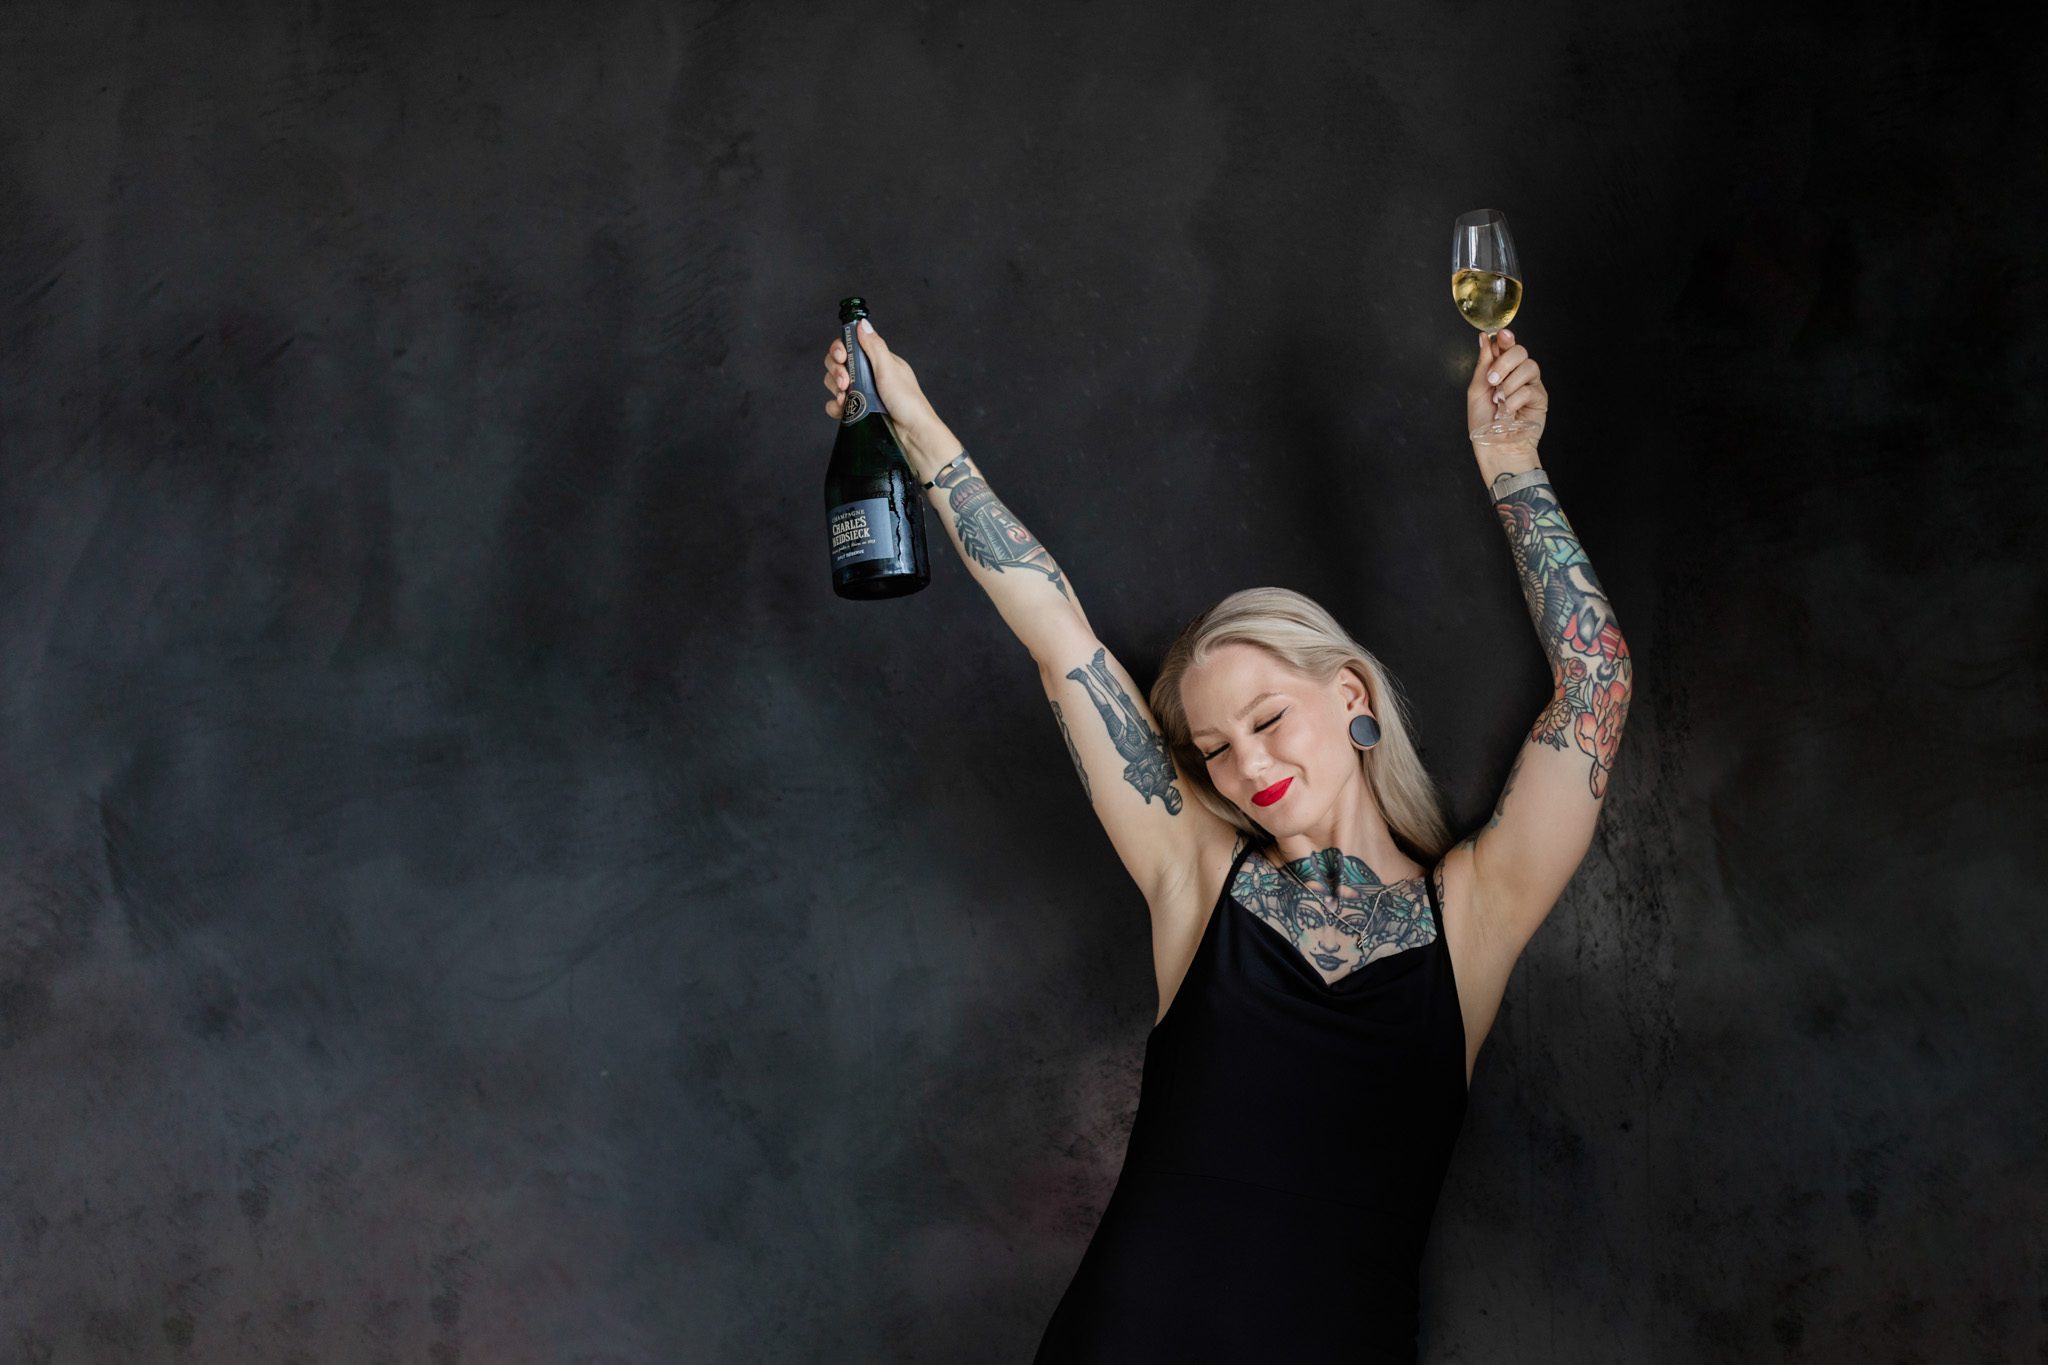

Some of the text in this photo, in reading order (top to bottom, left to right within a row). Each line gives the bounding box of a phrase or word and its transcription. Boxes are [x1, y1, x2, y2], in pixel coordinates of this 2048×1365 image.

[832, 509, 865, 523] CHAMPAGNE
[832, 516, 867, 536] CHARLES
[832, 527, 871, 548] HEIDSIECK
